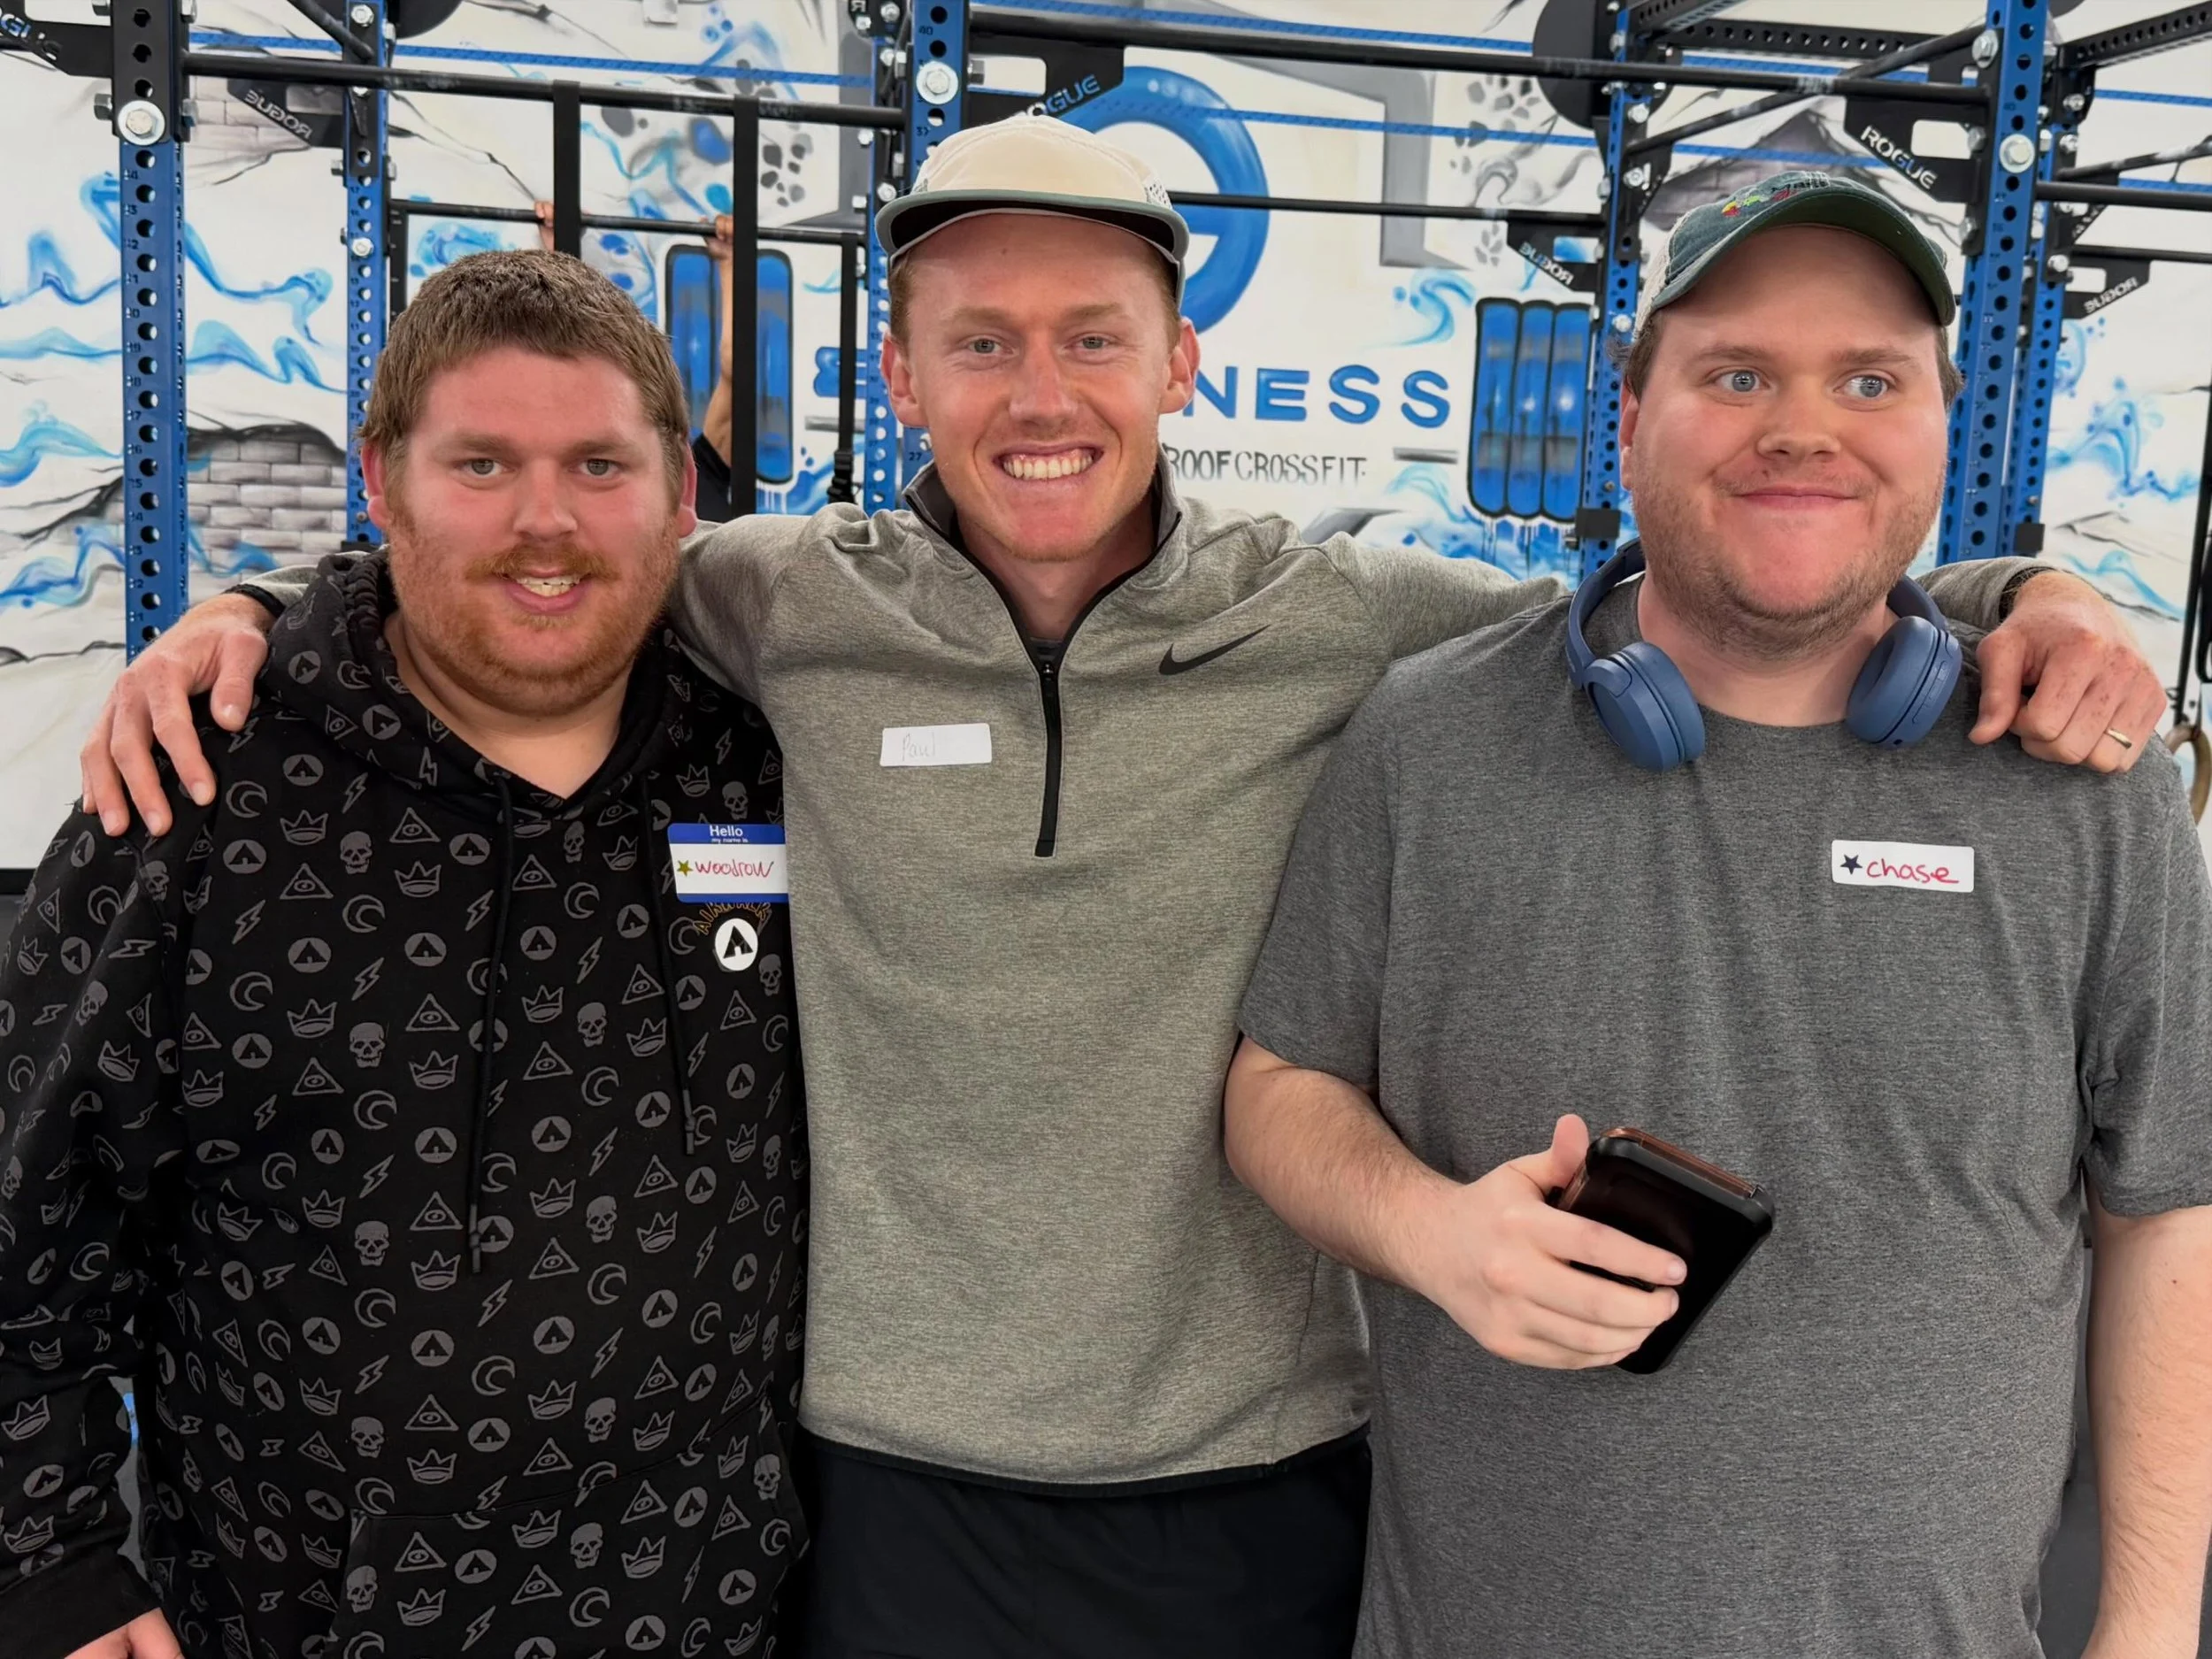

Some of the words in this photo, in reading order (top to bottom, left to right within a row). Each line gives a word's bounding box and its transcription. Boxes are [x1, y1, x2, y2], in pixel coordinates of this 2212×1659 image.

[1018, 73, 1101, 117] OGUE
[1861, 126, 1938, 189] ROGUE
[710, 825, 743, 837] Hello
